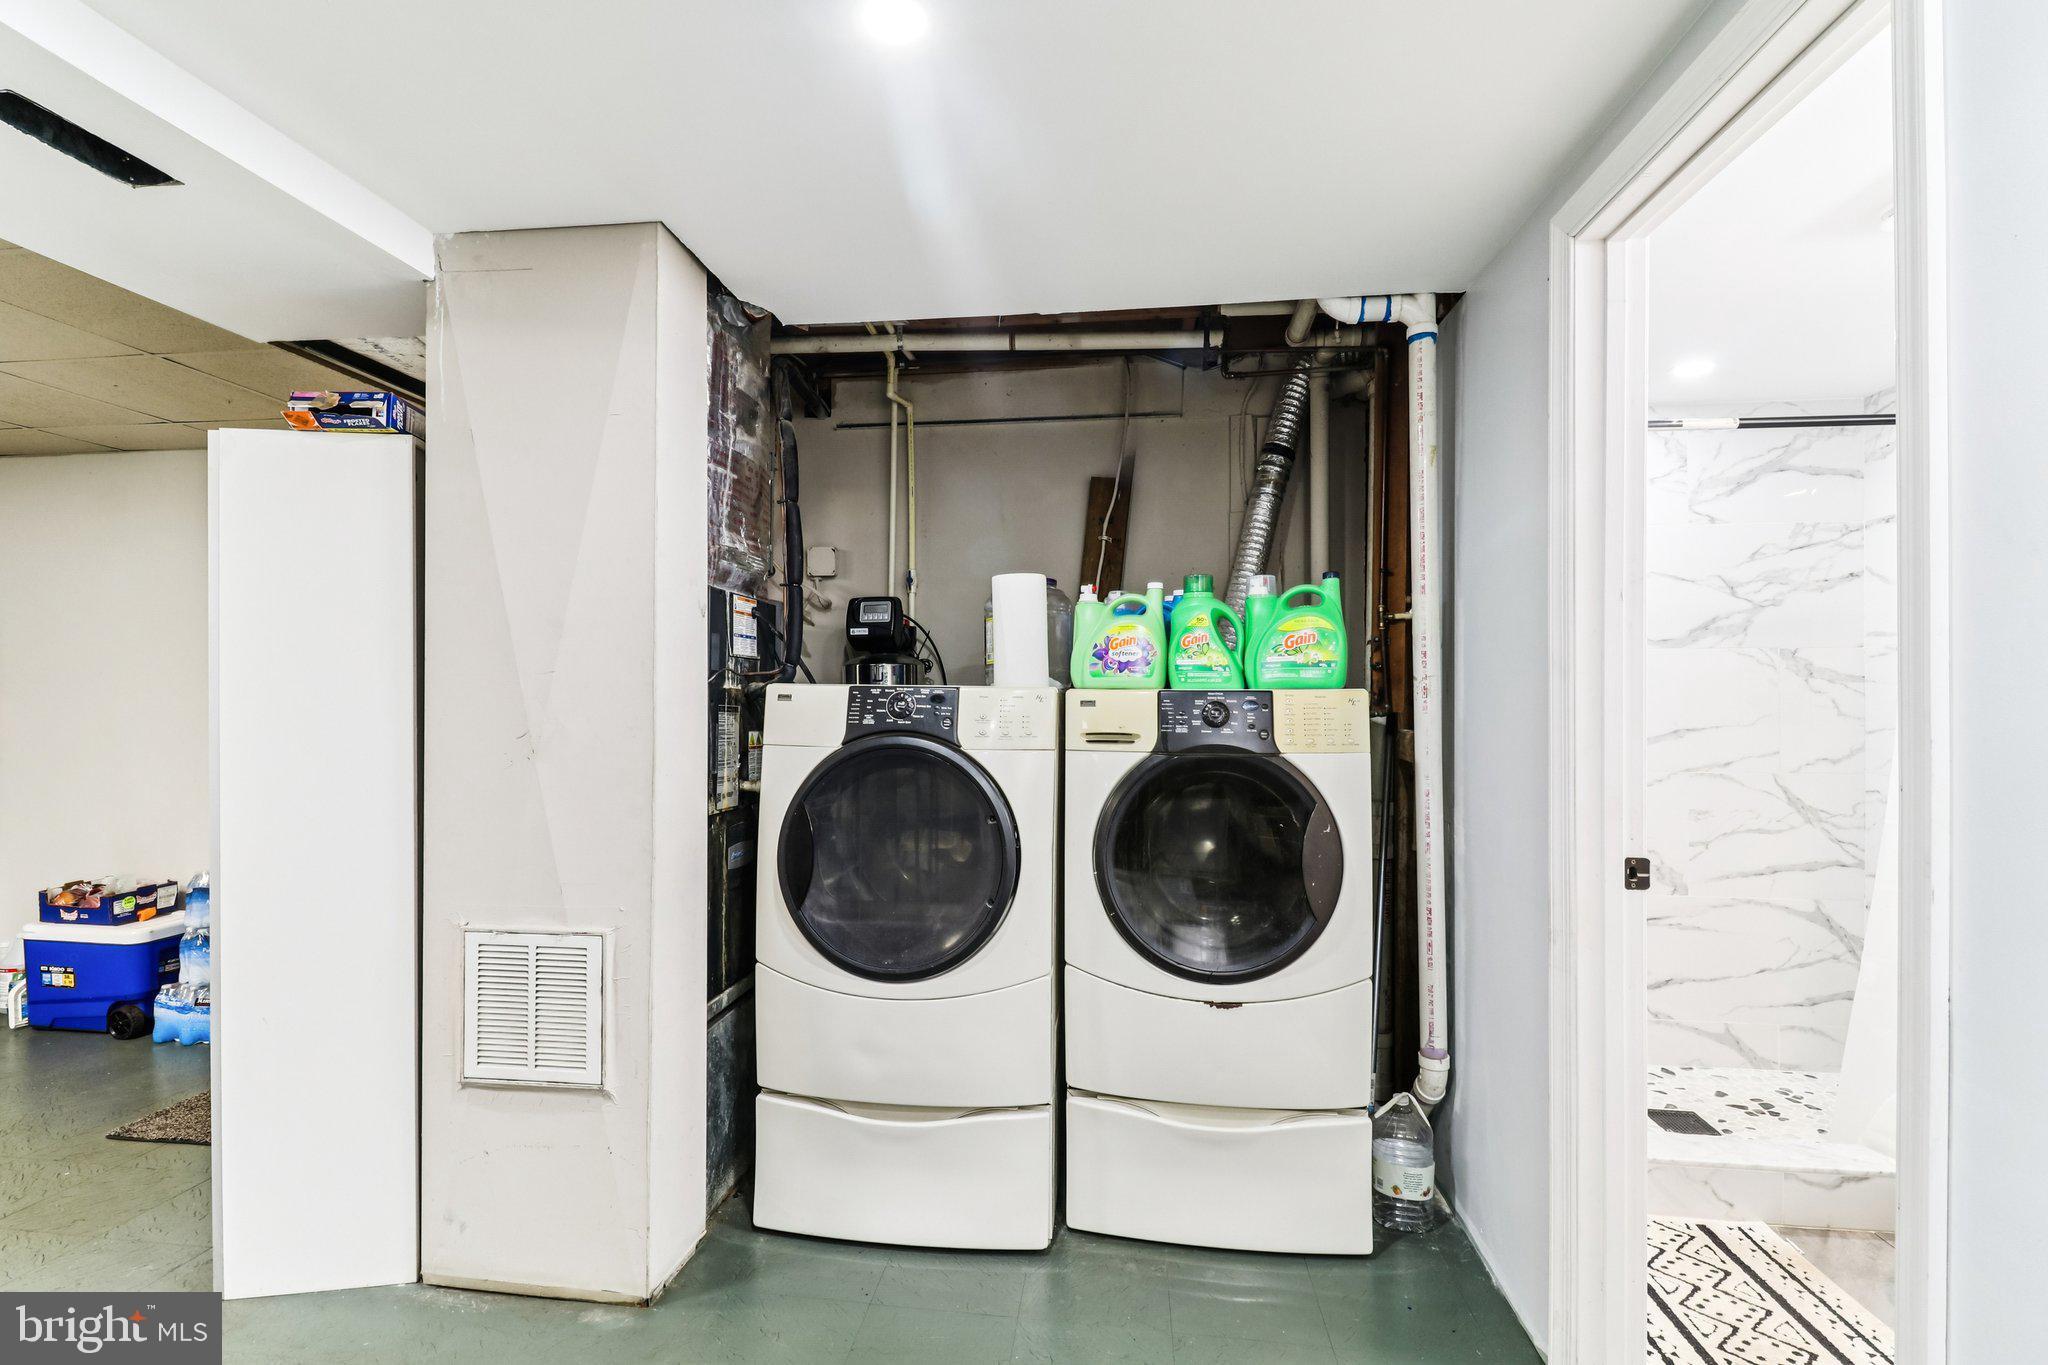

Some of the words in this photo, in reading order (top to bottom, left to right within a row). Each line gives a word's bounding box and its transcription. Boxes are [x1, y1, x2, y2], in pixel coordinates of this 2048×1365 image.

[1109, 636, 1137, 650] Gain
[1181, 633, 1209, 648] Gain
[1284, 631, 1317, 649] Gain
